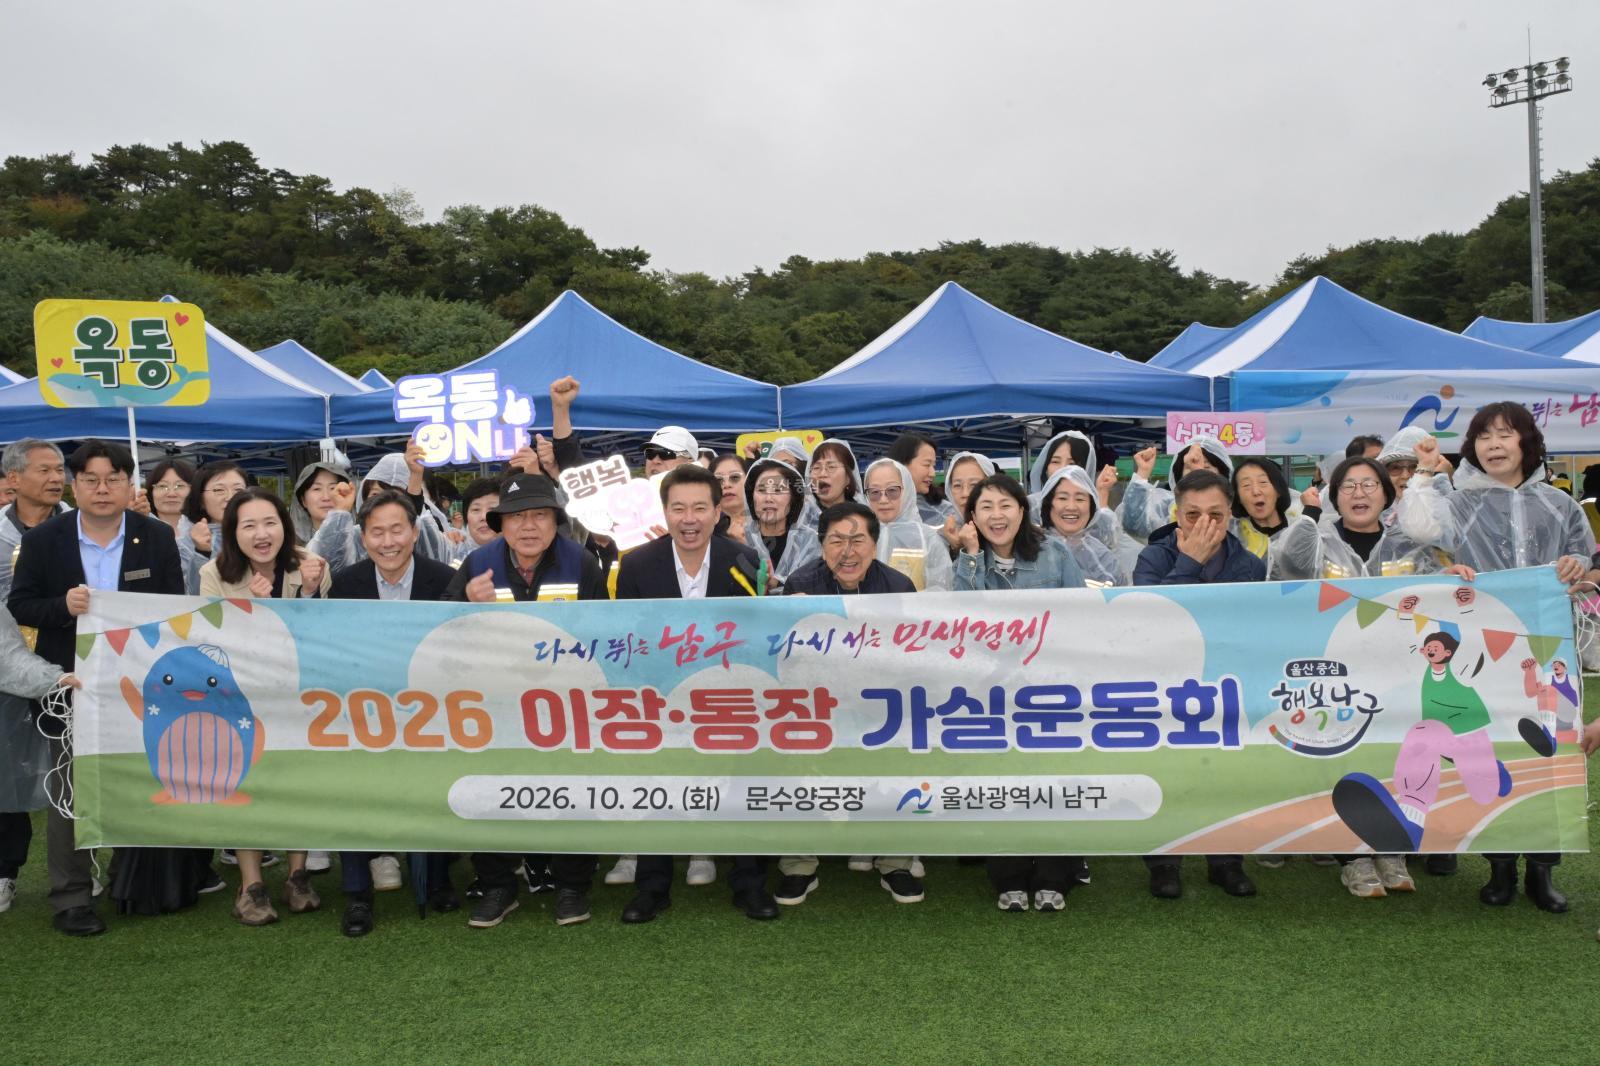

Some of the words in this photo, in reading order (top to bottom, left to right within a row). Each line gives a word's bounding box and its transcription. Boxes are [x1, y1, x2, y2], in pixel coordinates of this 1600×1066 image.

[73, 315, 176, 389] 옥동
[397, 372, 498, 423] 옥동
[534, 638, 598, 664] 다시
[604, 632, 649, 669] 뛰는
[658, 621, 747, 669] 남구
[766, 627, 836, 660] 다시
[841, 622, 881, 659] 서는
[892, 610, 1050, 665] 민생경제
[1290, 663, 1313, 676] 울산
[1316, 662, 1340, 675] 중심
[302, 690, 493, 749] 2026
[520, 686, 839, 750] 이장·통장
[860, 677, 1240, 750] 가실운동회
[1271, 682, 1385, 736] 행복남구
[500, 786, 577, 810] 2026.
[586, 786, 625, 810] 10.
[632, 786, 674, 810] 20.
[682, 785, 721, 812] (화)
[746, 786, 867, 812] 문수양궁장
[940, 785, 1054, 811] 울산광역시
[1062, 785, 1108, 810] 남구
